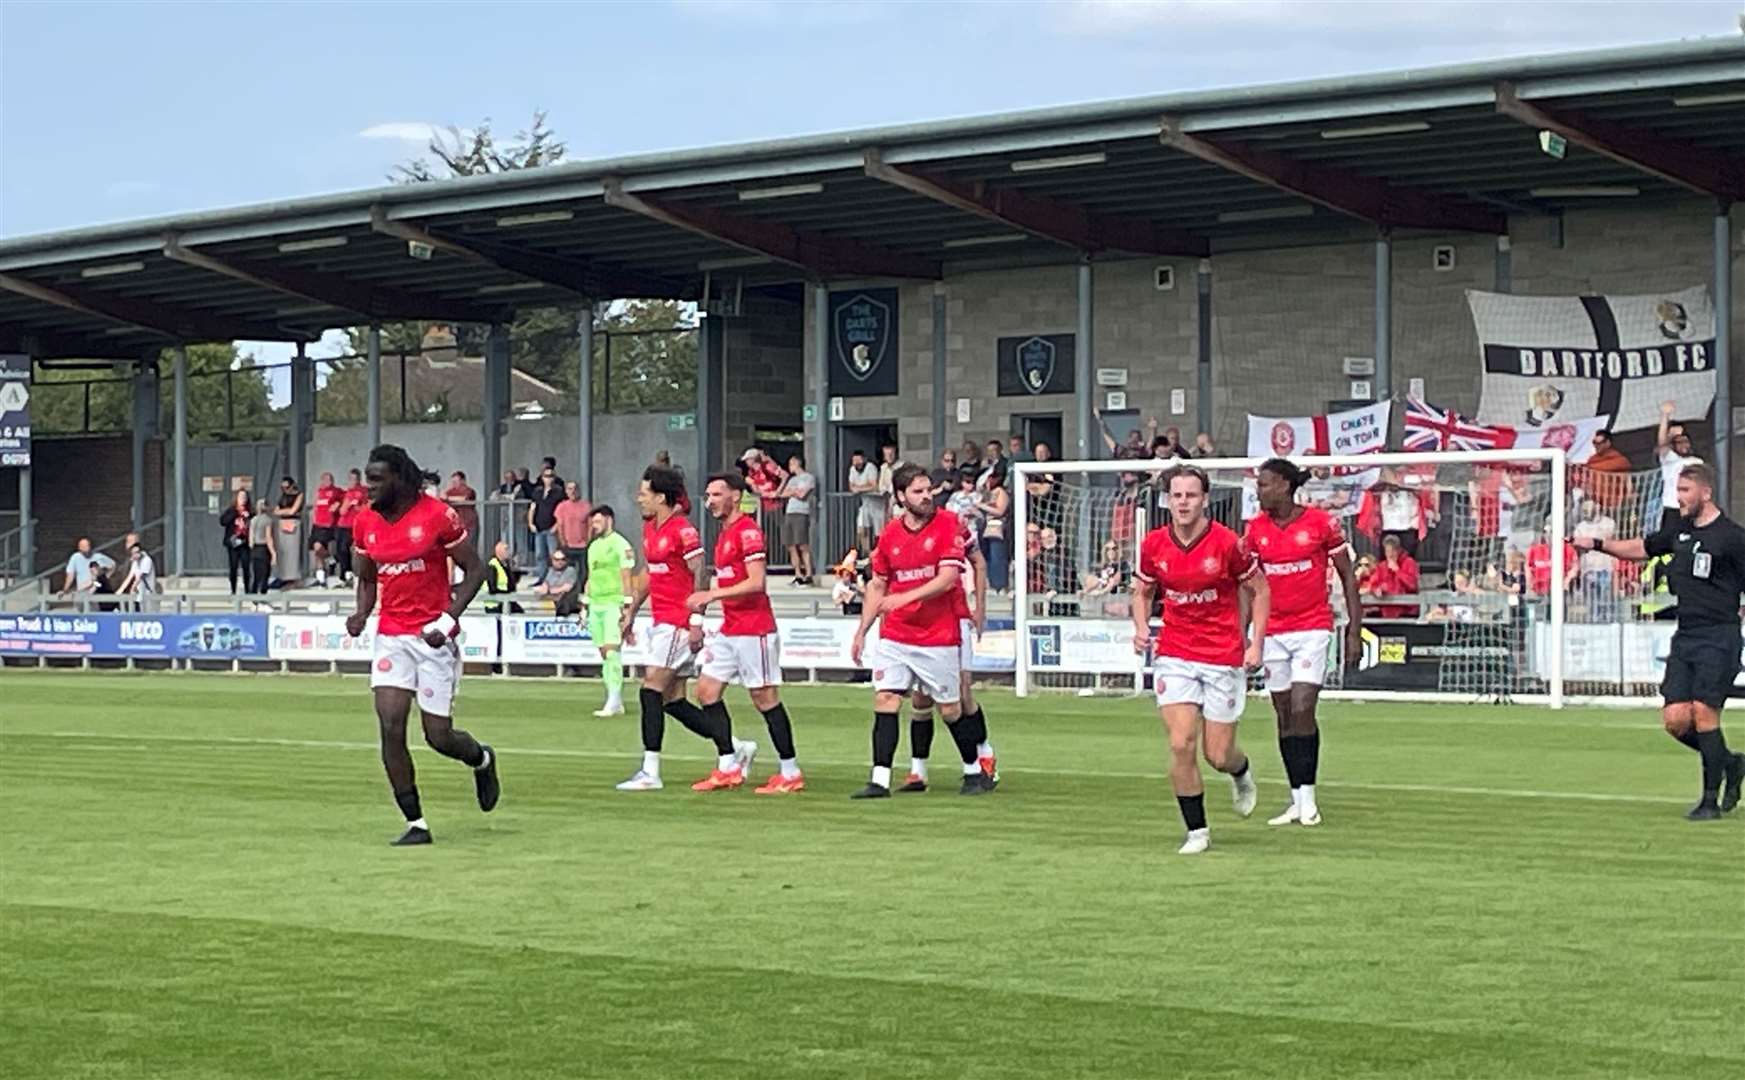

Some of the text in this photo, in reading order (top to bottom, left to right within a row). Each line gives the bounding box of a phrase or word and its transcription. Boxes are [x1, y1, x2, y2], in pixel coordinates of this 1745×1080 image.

[1520, 343, 1706, 379] DARTFORD FC
[43, 617, 51, 633] &
[120, 621, 163, 640] IVECO
